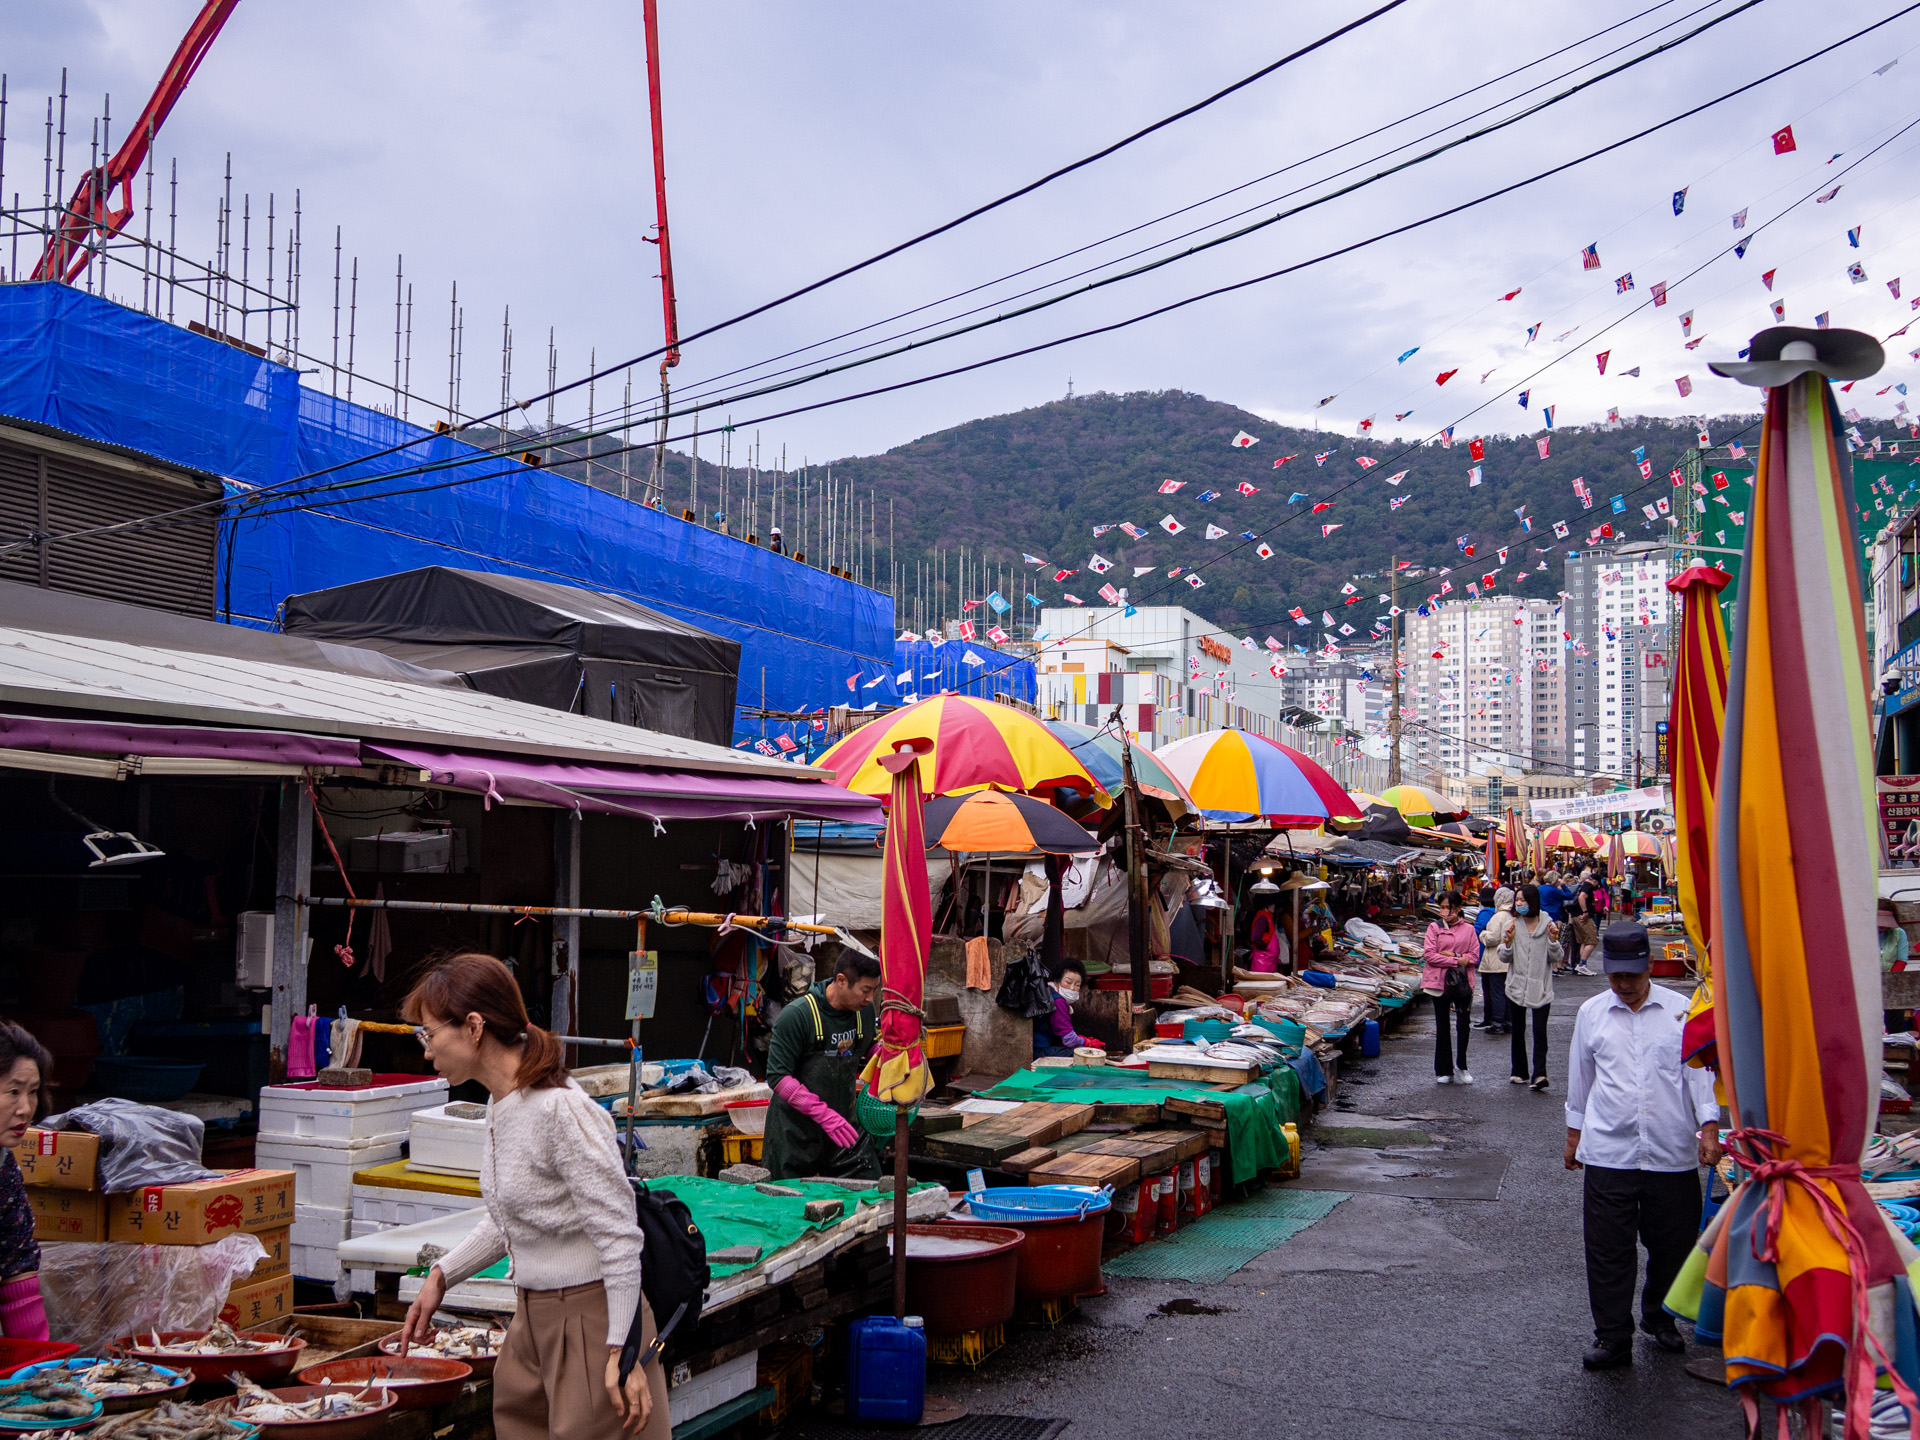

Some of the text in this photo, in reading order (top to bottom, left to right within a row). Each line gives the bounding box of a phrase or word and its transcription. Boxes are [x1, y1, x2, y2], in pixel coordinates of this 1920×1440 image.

[831, 1029, 857, 1045] SEOU
[21, 1153, 74, 1175] 국 산
[128, 1210, 181, 1230] 국 산
[245, 1216, 268, 1226] PRODUCT
[277, 1210, 293, 1220] KOREA
